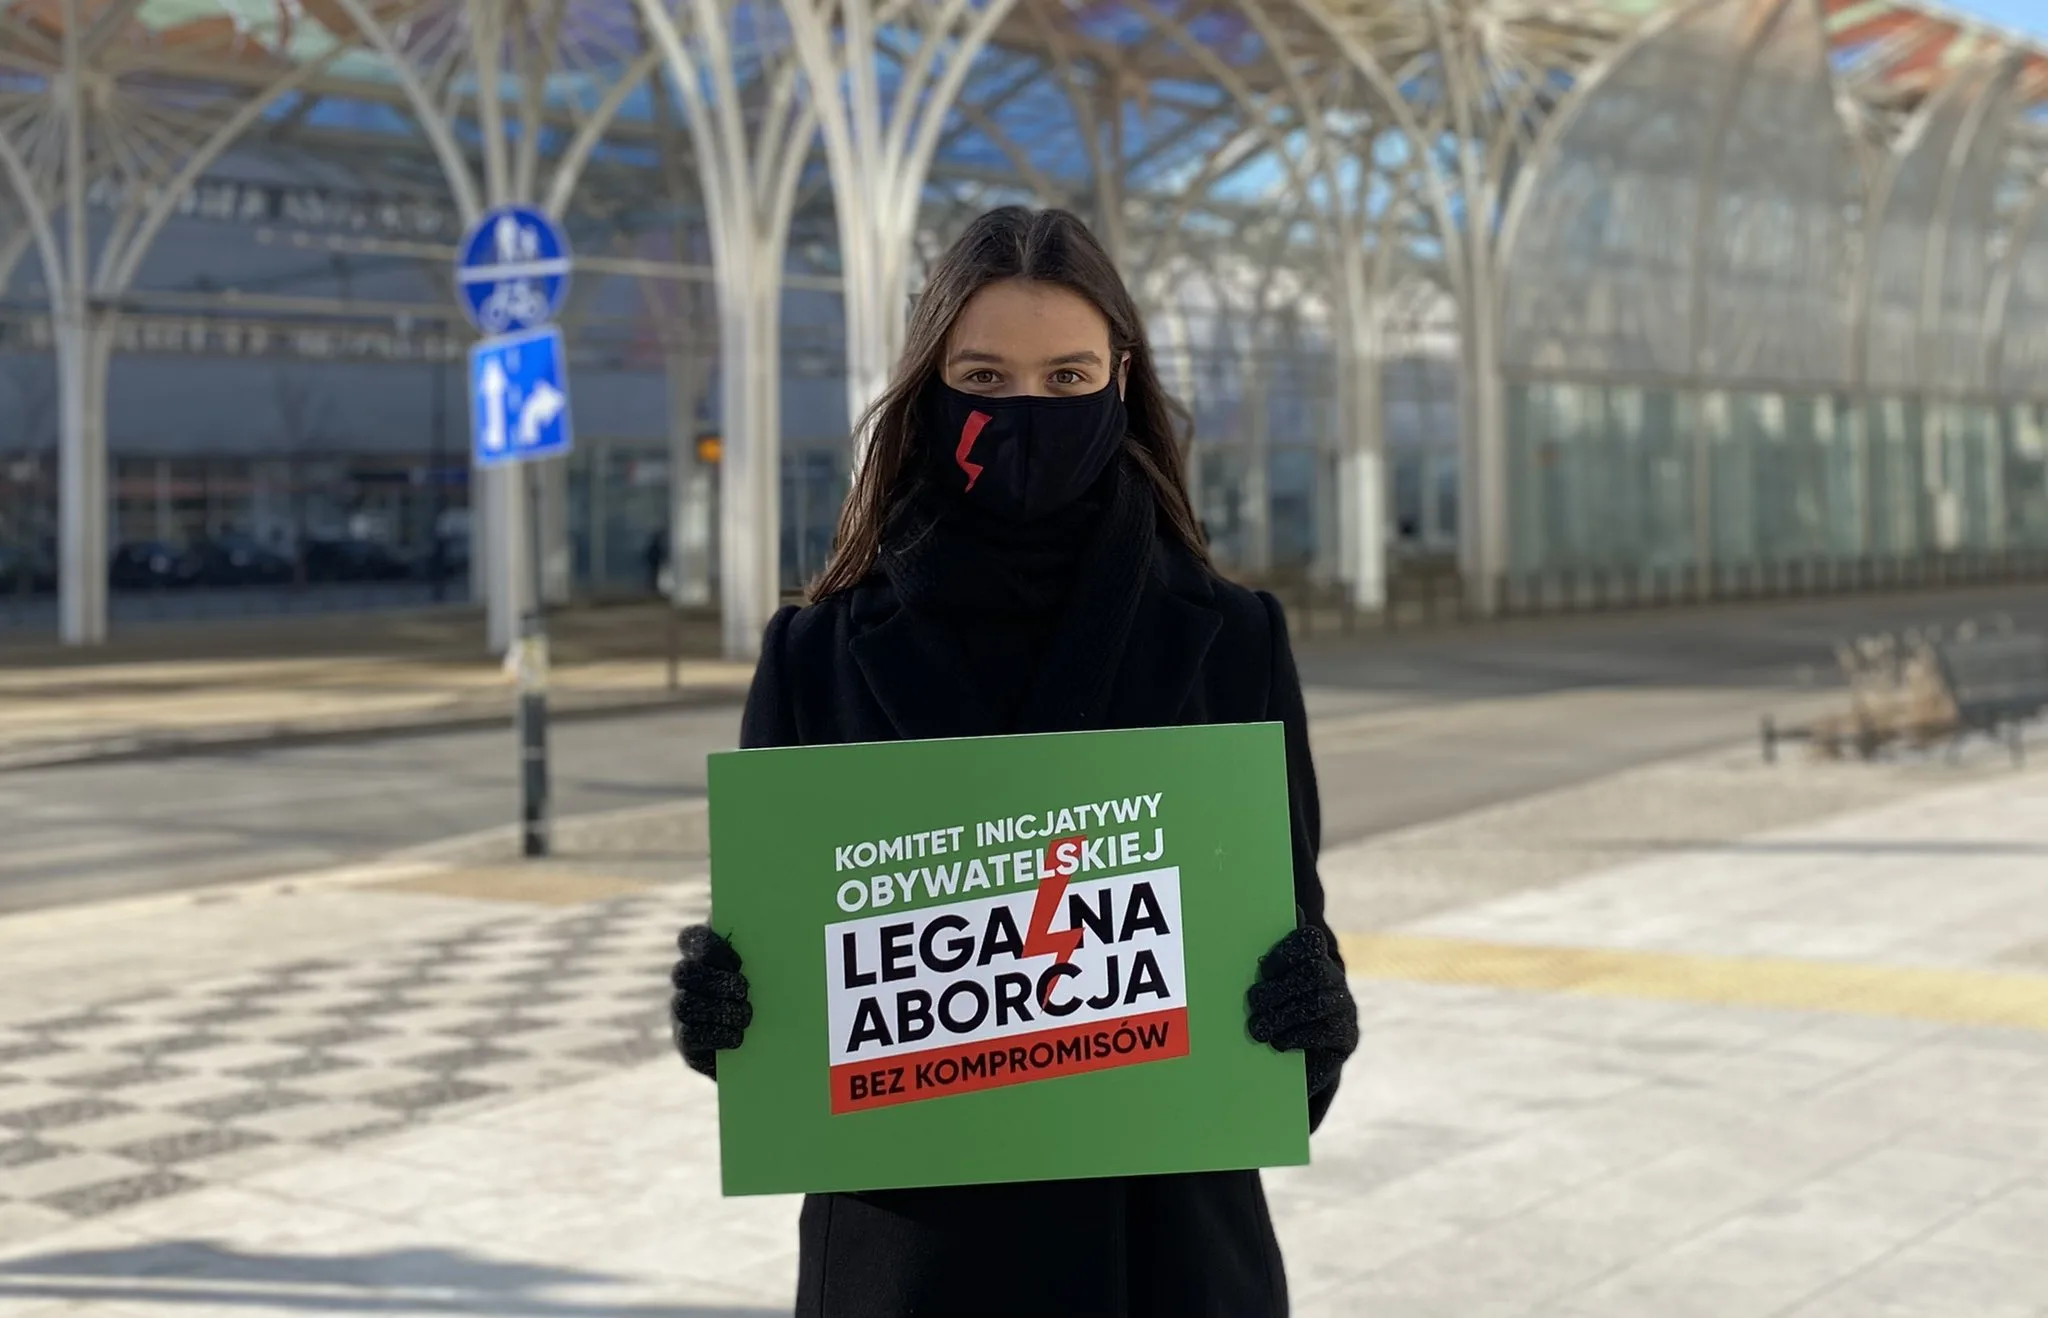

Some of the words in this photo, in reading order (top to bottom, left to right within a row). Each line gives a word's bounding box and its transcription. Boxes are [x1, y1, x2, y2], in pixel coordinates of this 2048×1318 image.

[835, 826, 964, 871] KOMITET
[976, 792, 1163, 847] INICJATYWY
[836, 828, 1165, 912] OBYWATELSKIEJ
[845, 948, 1171, 1053] ABORCJA
[850, 1067, 905, 1100] BEZ
[915, 1020, 1169, 1089] KOMPROMISÓW
